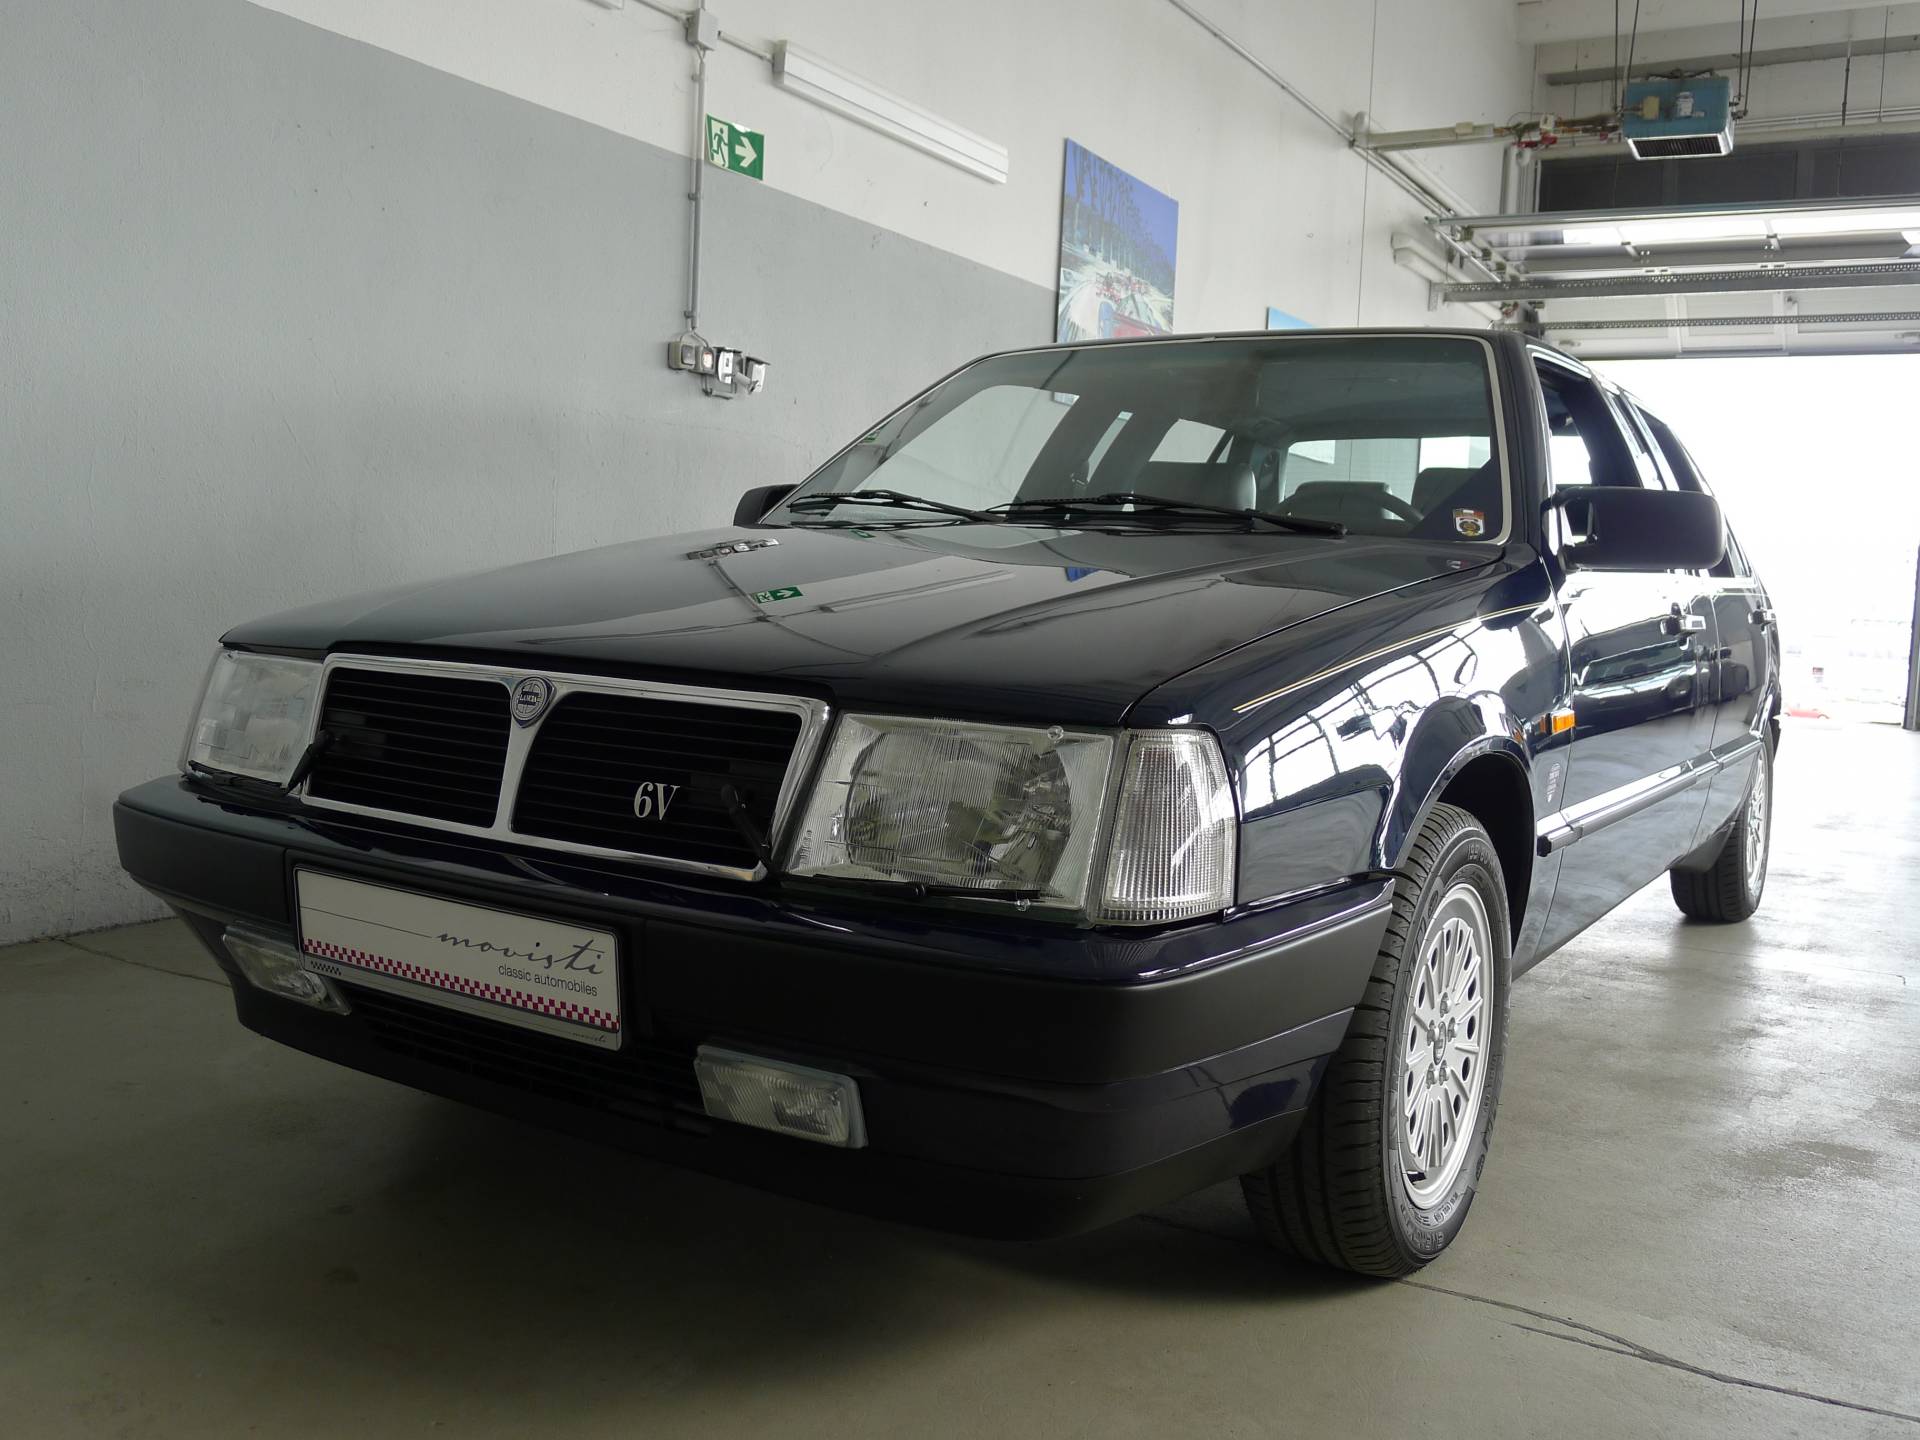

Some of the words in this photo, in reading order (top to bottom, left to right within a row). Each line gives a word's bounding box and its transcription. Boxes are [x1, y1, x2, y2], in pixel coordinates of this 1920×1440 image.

[633, 781, 681, 821] 6V
[437, 933, 605, 975] movisti
[498, 964, 531, 982] classic
[534, 973, 598, 997] automobiles
